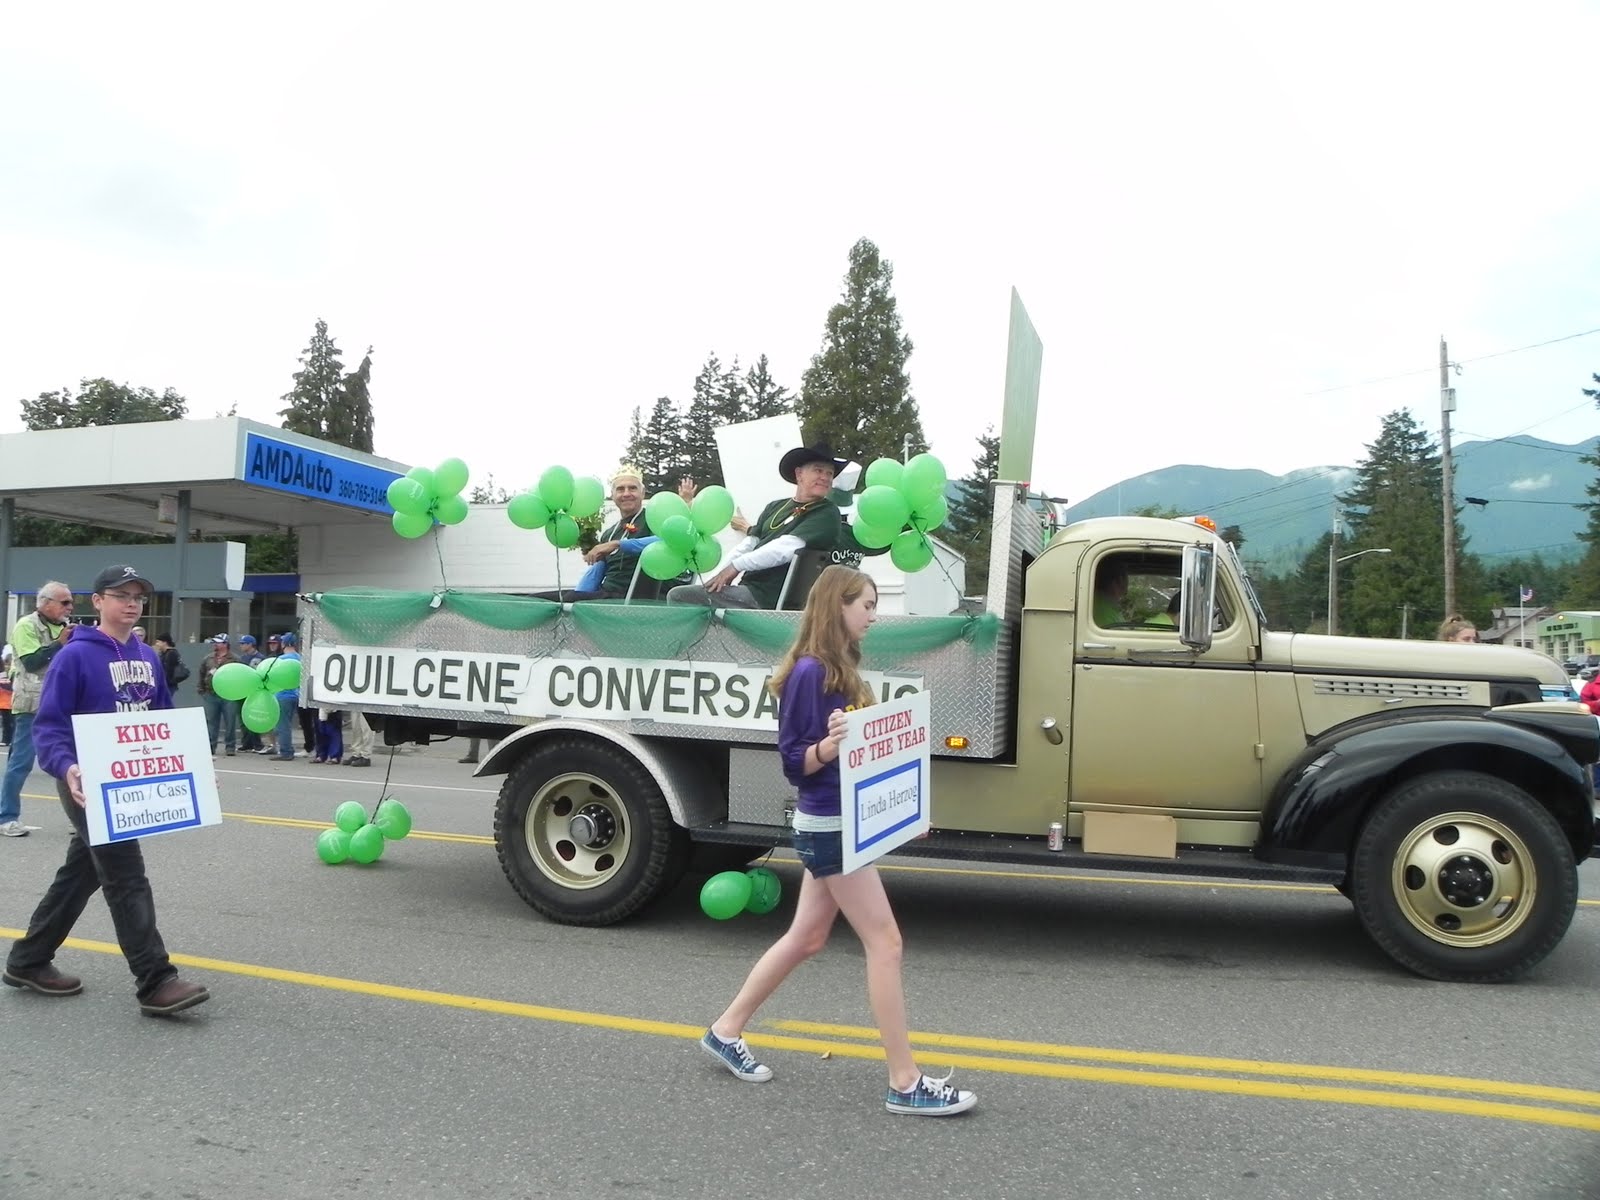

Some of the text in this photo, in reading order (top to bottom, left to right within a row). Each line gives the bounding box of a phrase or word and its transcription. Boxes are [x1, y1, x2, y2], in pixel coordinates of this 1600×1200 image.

[323, 653, 920, 720] QUILCENE CONVERSA
[115, 722, 171, 743] KING
[863, 709, 912, 740] CITIZEN
[848, 726, 926, 769] OF THE YEAR
[111, 755, 185, 779] QUEEN
[111, 789, 145, 804] Tom
[156, 783, 188, 799] Cass
[861, 785, 917, 821] Linda Herzog
[115, 806, 188, 829] Brotherton
